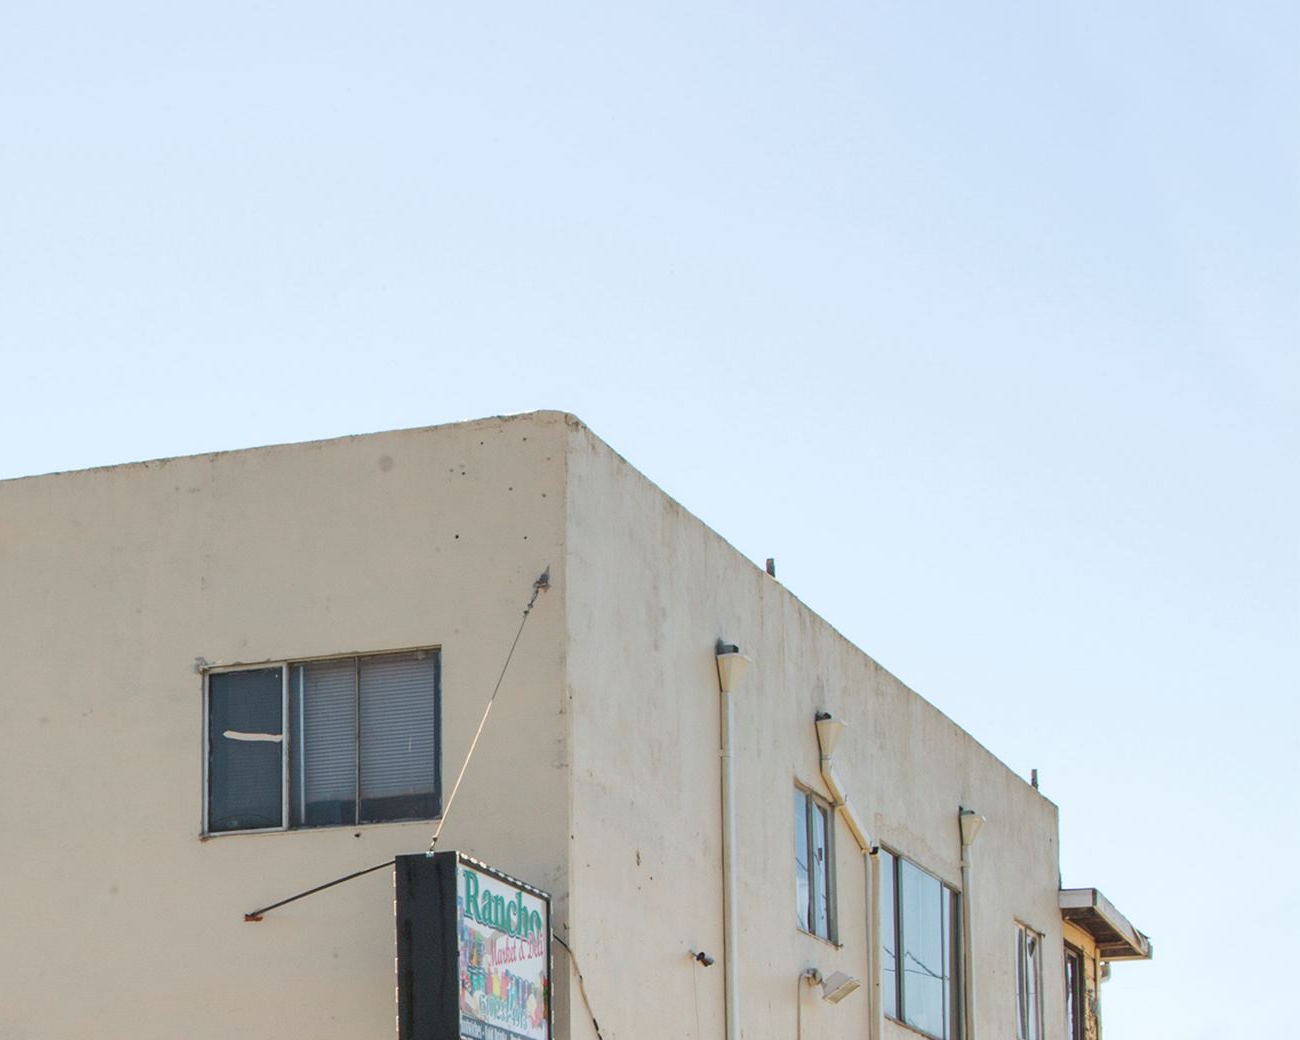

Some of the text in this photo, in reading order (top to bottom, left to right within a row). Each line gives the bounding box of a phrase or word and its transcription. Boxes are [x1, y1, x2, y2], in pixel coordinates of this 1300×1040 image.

[463, 869, 542, 942] Rancho
[488, 936, 518, 967] Market
[527, 931, 544, 959] Deli
